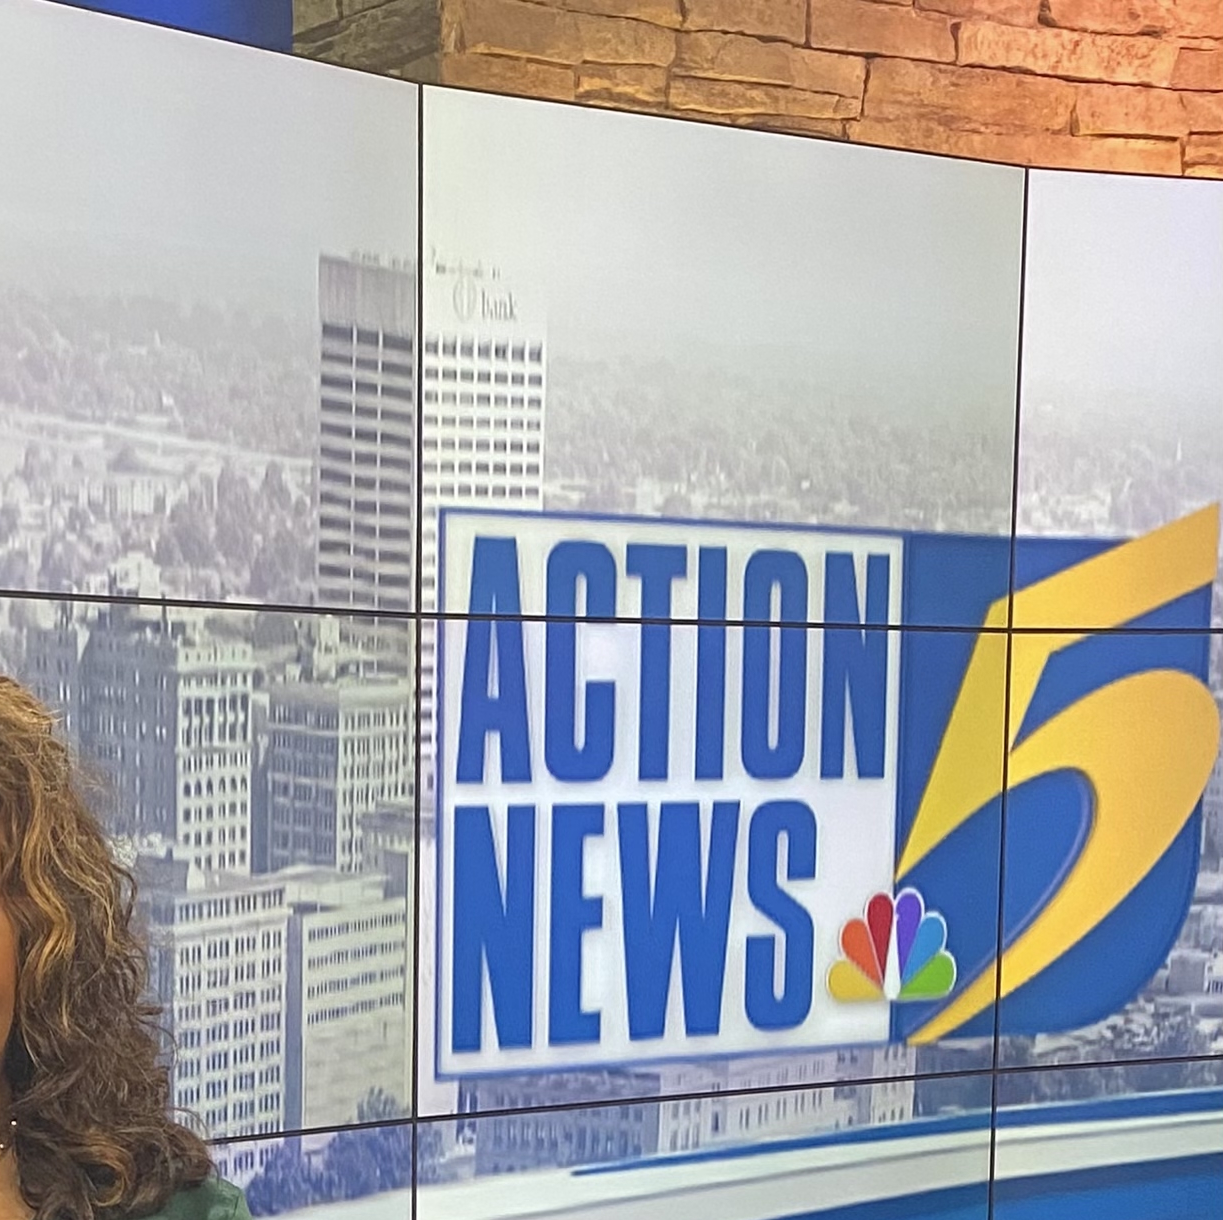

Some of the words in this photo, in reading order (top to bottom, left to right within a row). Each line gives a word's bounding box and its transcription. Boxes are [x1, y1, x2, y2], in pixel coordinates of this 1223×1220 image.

[456, 535, 891, 786] ACTION
[894, 502, 1221, 1047] 5
[451, 800, 817, 1054] NEWS
